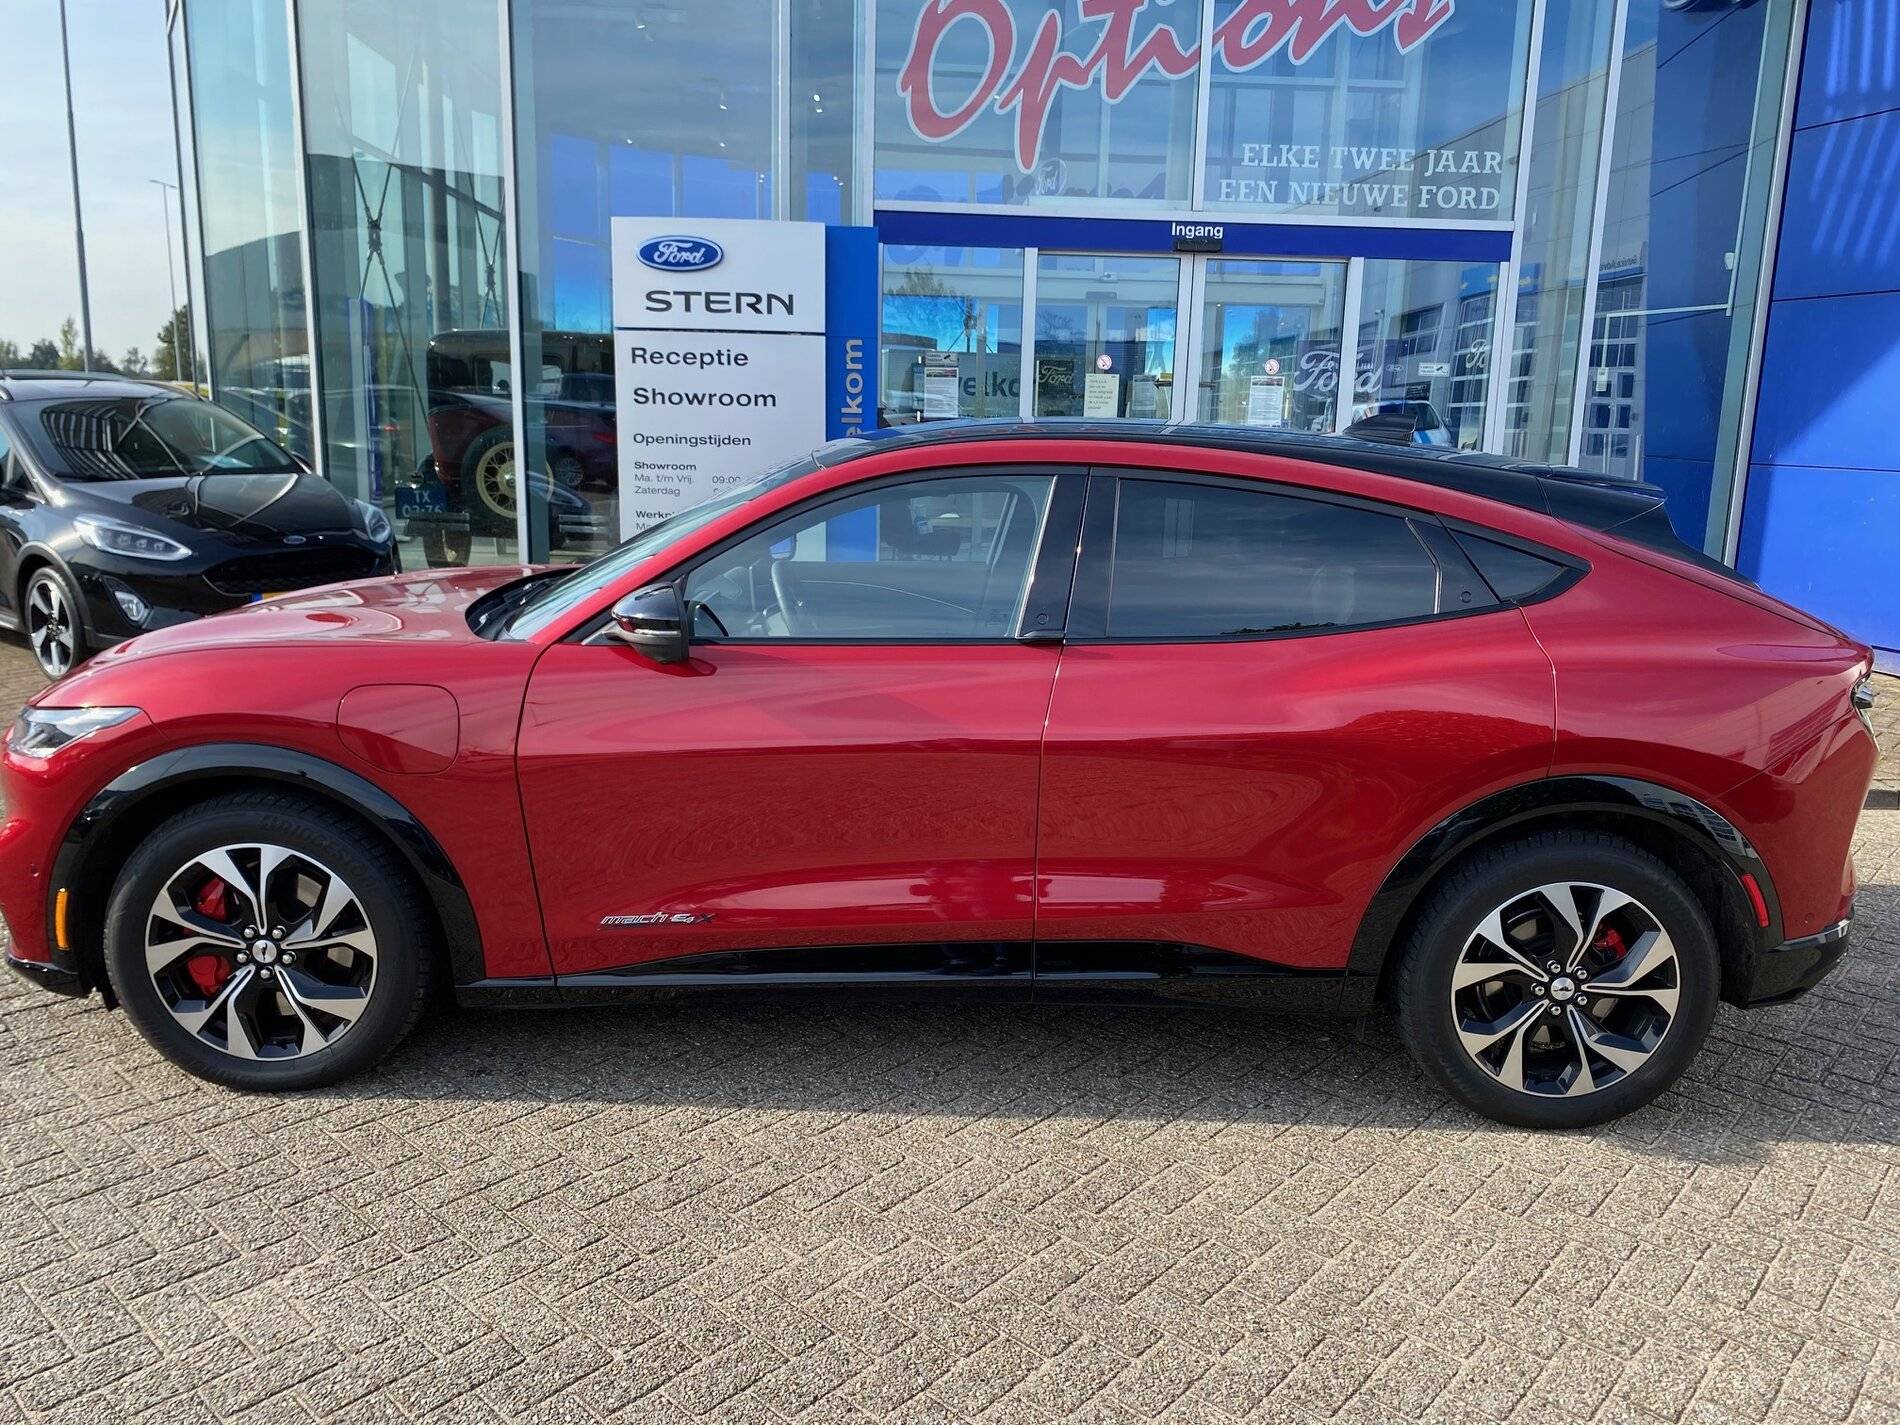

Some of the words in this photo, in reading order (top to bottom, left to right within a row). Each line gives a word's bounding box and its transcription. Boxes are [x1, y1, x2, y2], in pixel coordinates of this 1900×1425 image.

[1241, 143, 1320, 169] ELKE
[1331, 146, 1415, 172] TWEE
[1424, 150, 1503, 177] JAAR
[1219, 179, 1278, 203] EEN
[1288, 182, 1409, 207] NIEUWE
[1418, 185, 1500, 210] FORD
[1171, 222, 1224, 239] Ingang
[652, 241, 706, 265] Ford
[645, 290, 794, 315] STERN
[631, 347, 749, 369] Receptie
[633, 387, 777, 408] Showroom
[633, 433, 752, 448] Openingstijden
[634, 461, 697, 471] Showroom
[634, 474, 654, 483] Ma.
[656, 474, 674, 483] t/m
[676, 475, 695, 485] Vrij.
[414, 490, 431, 503] TX
[634, 485, 681, 497] Zaterdag
